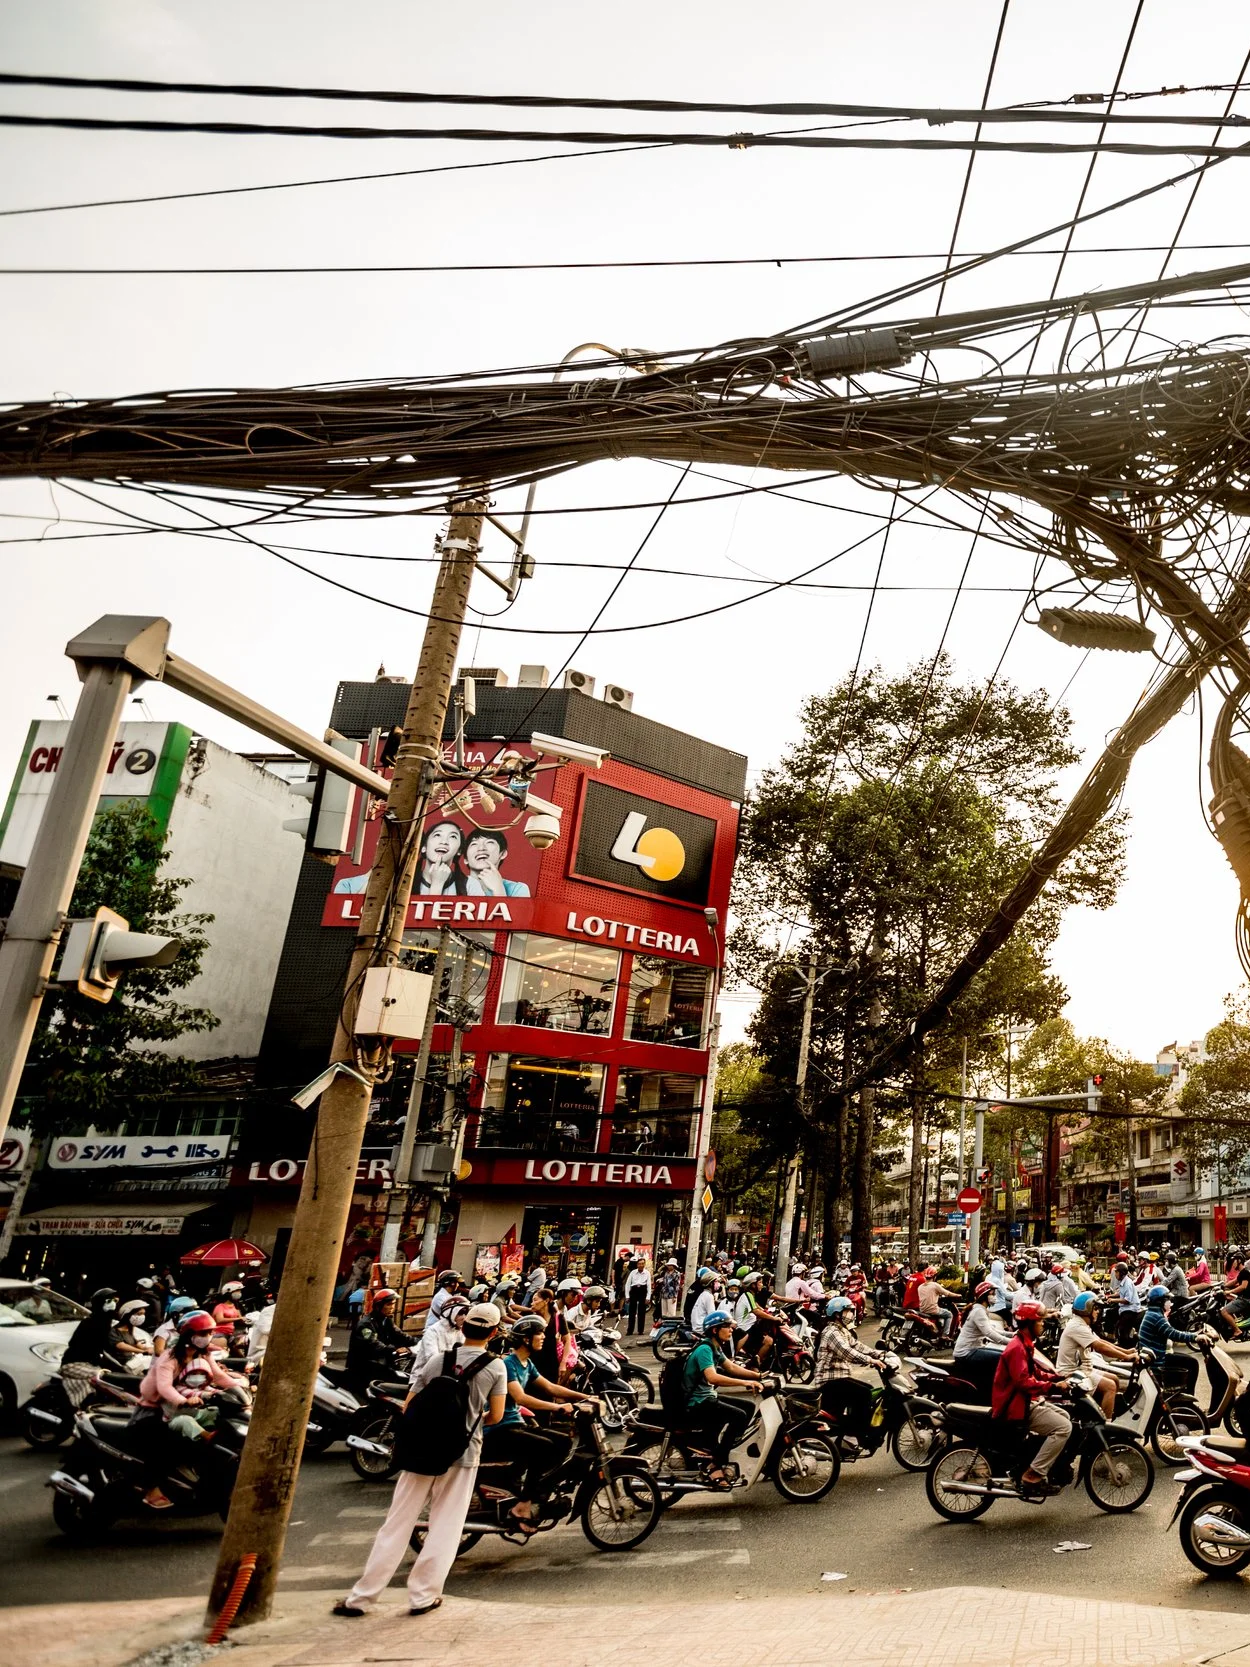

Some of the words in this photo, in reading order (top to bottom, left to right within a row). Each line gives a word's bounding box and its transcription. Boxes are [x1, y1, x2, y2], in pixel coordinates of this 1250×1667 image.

[131, 752, 149, 770] 2
[341, 900, 512, 922] LTERIA
[566, 911, 700, 957] LOTTERIA
[80, 1144, 128, 1161] SYM
[525, 1159, 673, 1185] LOTTERIA
[125, 1220, 145, 1230] SYM
